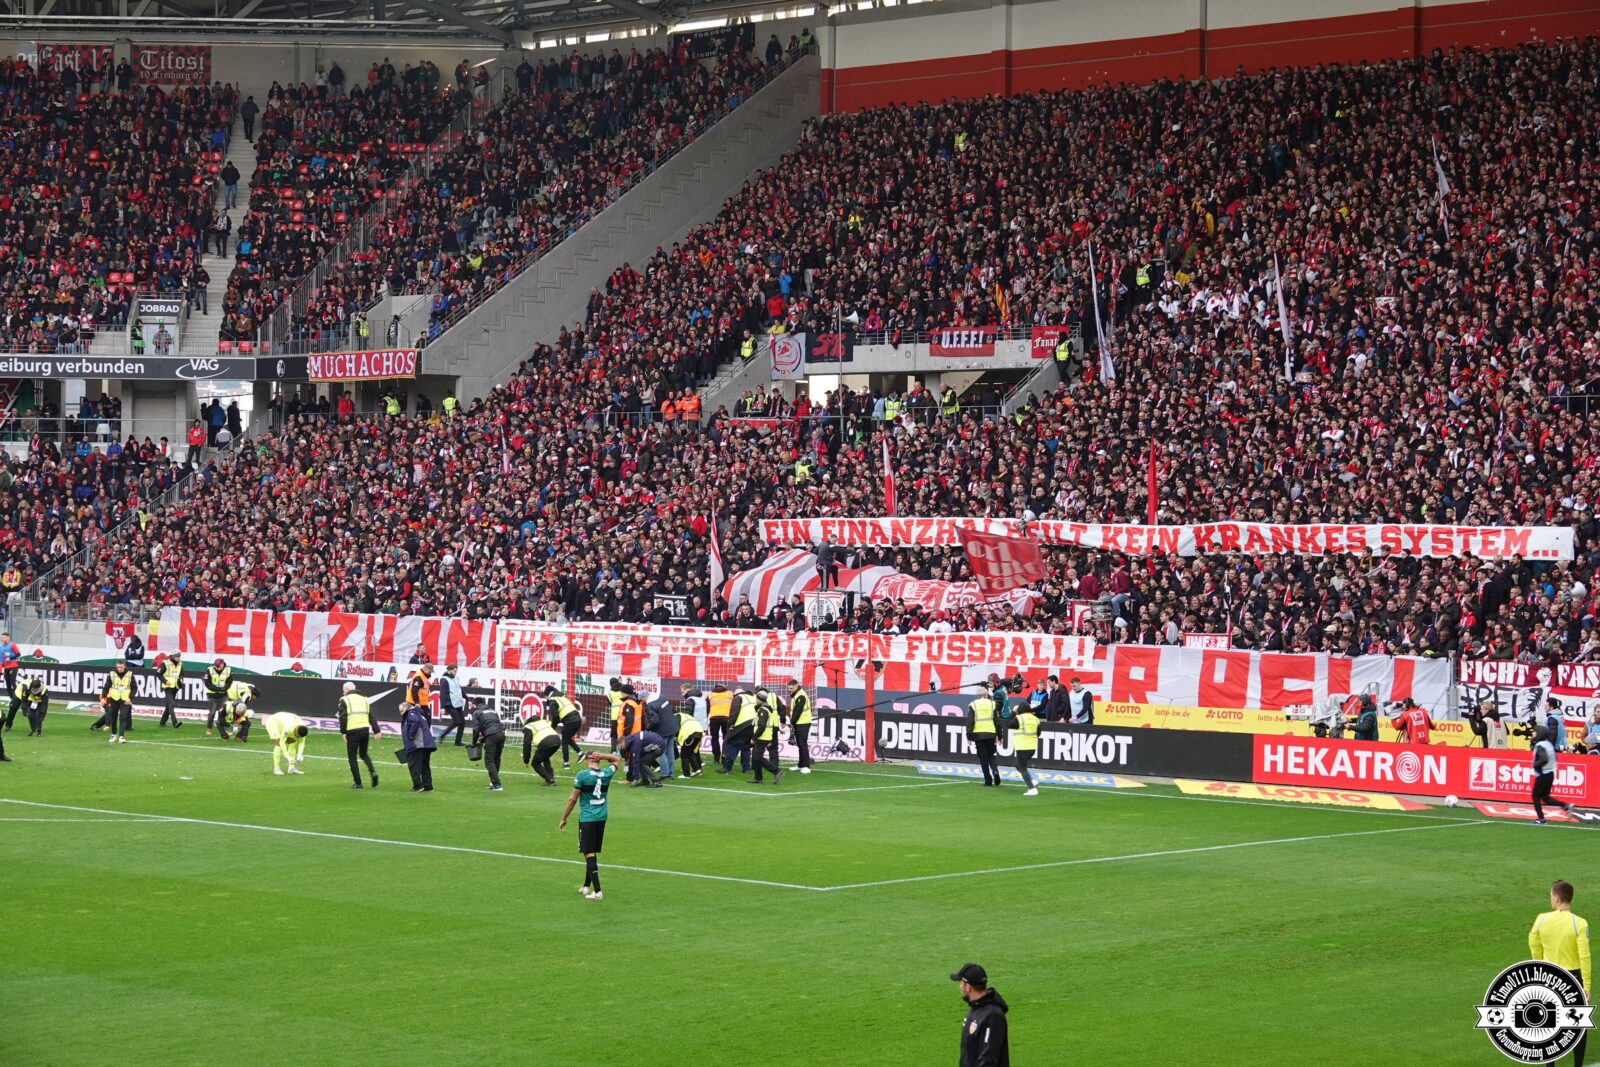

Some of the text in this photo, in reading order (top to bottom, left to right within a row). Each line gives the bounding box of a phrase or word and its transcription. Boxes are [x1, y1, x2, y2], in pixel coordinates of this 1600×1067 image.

[139, 49, 204, 70] Tifosi
[140, 305, 180, 313] JOBRAD
[56, 359, 145, 374] verbunden
[189, 359, 220, 371] VAG
[310, 351, 415, 378] MUCHACHOS
[765, 519, 815, 546] EIN
[1100, 524, 1182, 556] KEIN
[1192, 524, 1367, 554] KRANKES
[1380, 526, 1560, 558] SYSTEM...
[179, 608, 304, 658] NEIN
[905, 634, 1086, 668] FUSSBALL!
[347, 662, 374, 677] Rothaus
[1460, 660, 1529, 686] FIGHT
[1115, 705, 1141, 714] LOTTO
[1155, 709, 1190, 717] lotto-bw.de
[1216, 710, 1244, 719] LOTTO
[882, 721, 938, 751] DEIN
[1435, 723, 1464, 732] LOTTO
[1263, 744, 1447, 785] HEKATRON
[1498, 764, 1584, 786] strub
[592, 778, 602, 798] 4
[1256, 786, 1371, 804] LOTTO
[1499, 783, 1583, 795] VERPANGEN
